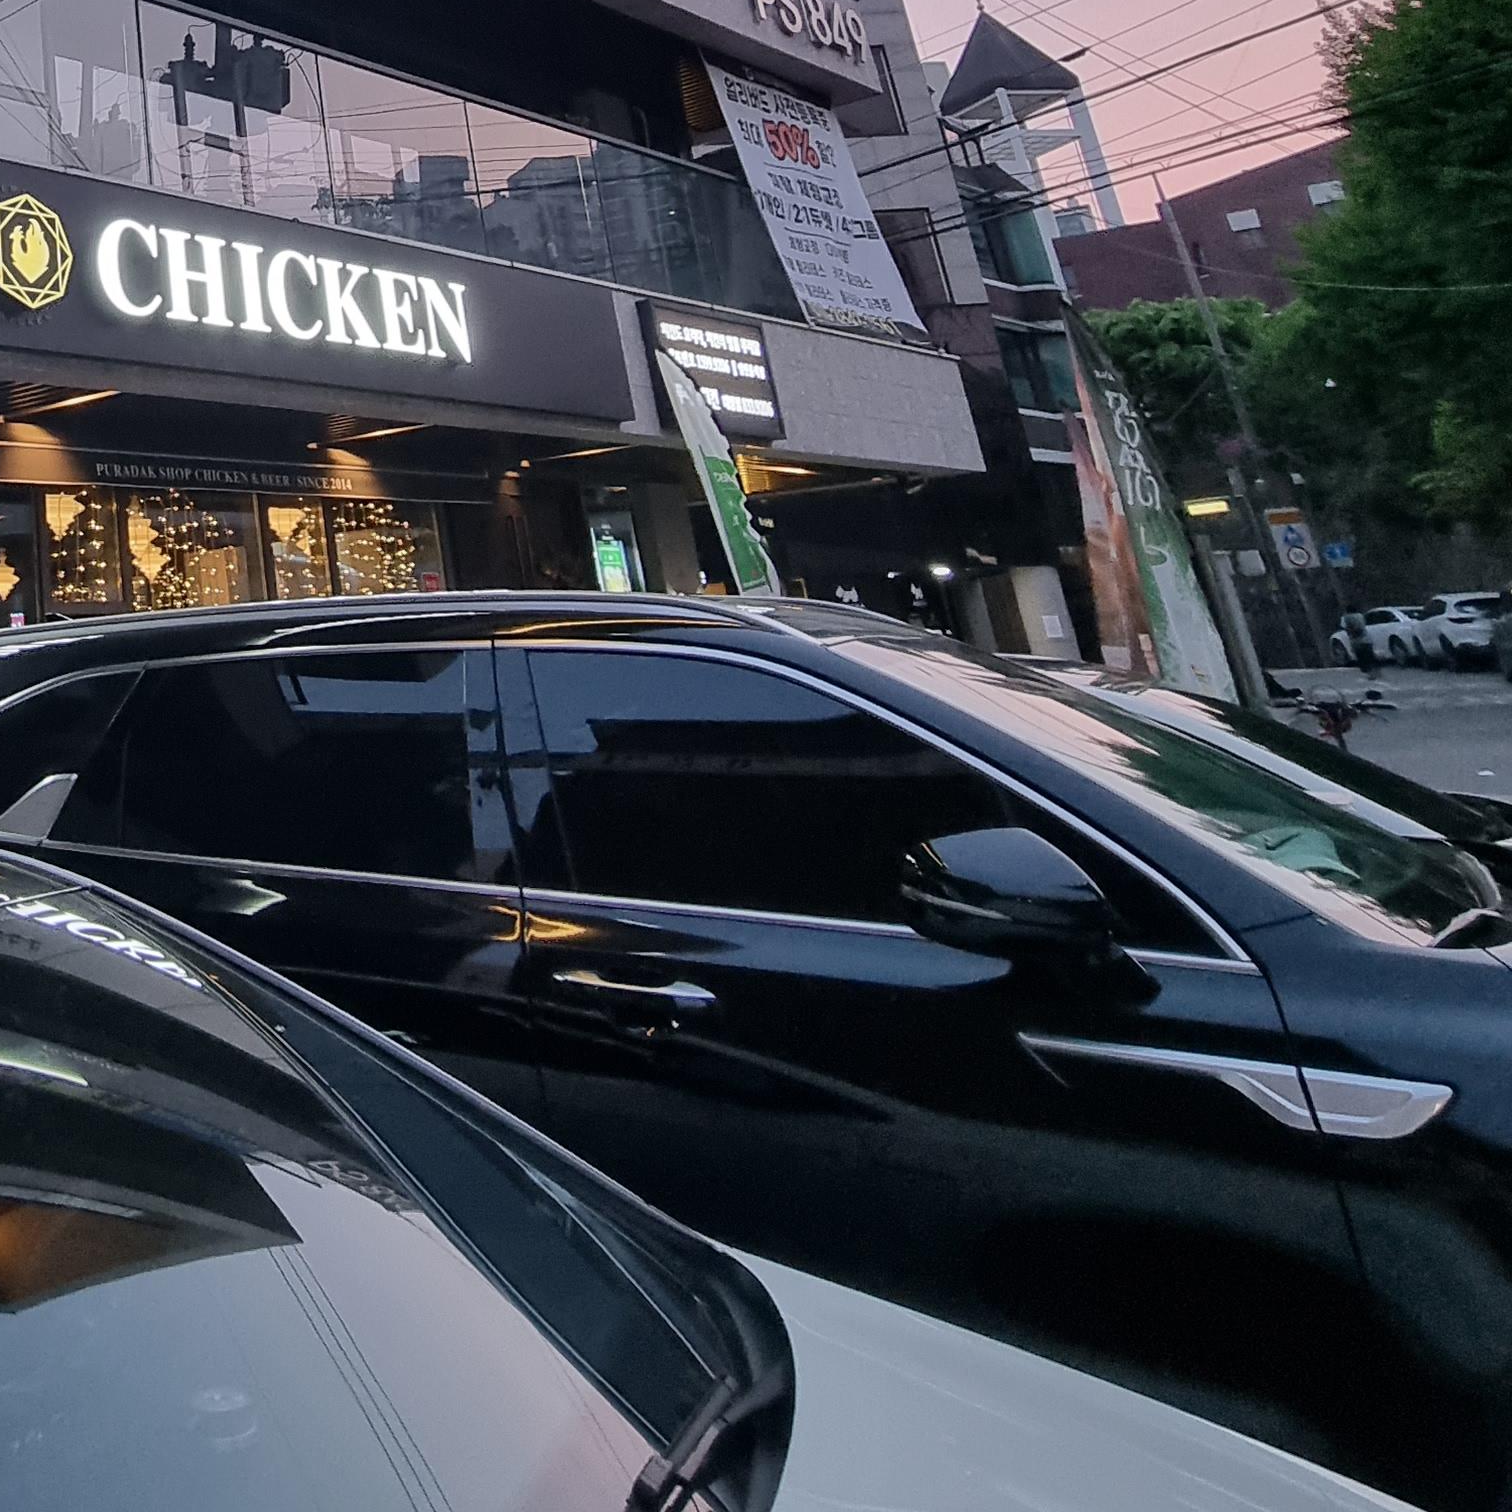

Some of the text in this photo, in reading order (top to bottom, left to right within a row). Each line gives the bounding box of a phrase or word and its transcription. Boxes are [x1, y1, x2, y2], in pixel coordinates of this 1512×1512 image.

[762, 117, 821, 170] 50%
[95, 218, 474, 363] CHICKEN
[96, 462, 157, 481] PURADAK
[159, 466, 192, 483] SHOP
[194, 469, 249, 486] CHICKEN
[262, 474, 290, 487] BEER
[296, 476, 330, 490] SINCE
[330, 477, 353, 492] 2014
